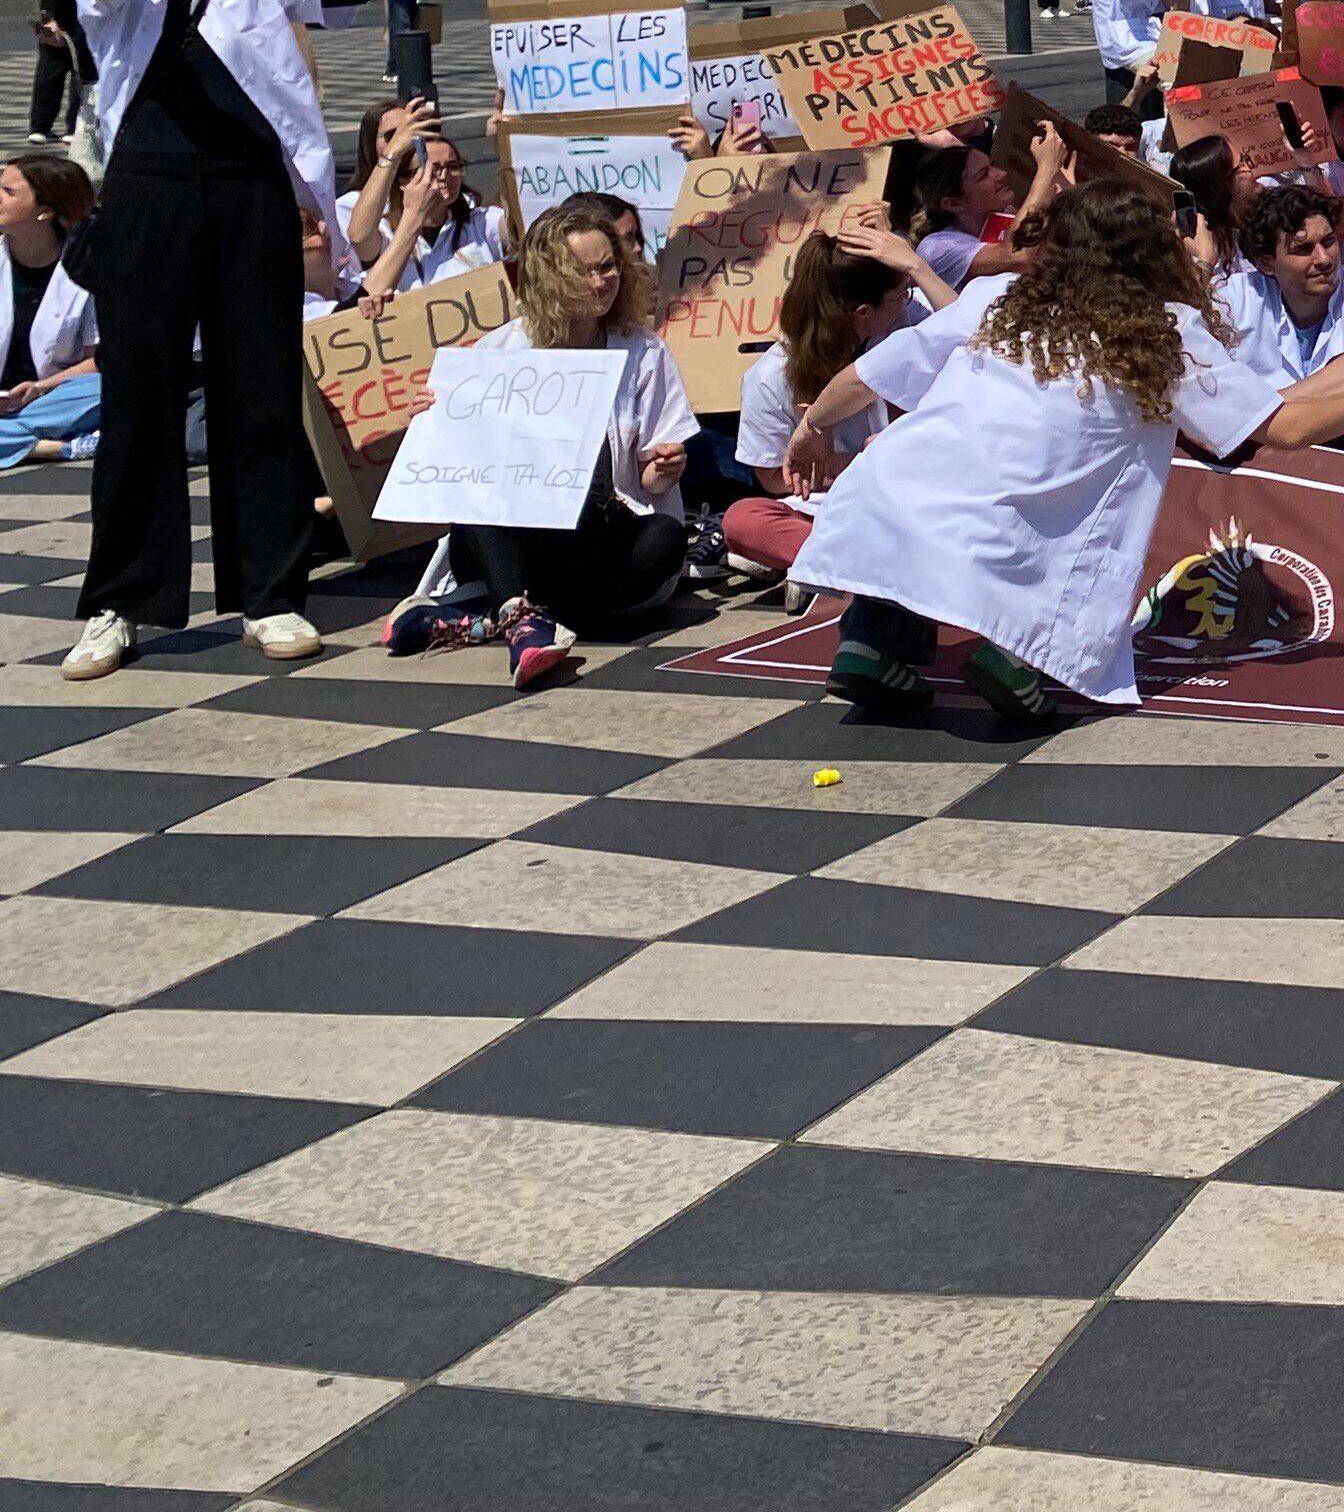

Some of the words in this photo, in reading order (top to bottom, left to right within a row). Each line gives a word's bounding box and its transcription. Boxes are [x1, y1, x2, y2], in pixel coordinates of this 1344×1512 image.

[616, 14, 667, 43] LES
[804, 53, 994, 122] PATIENTS
[519, 155, 662, 198] ABANDON
[693, 166, 763, 199] ON
[784, 161, 861, 196] NE
[679, 256, 754, 288] PAS
[425, 279, 512, 350] DU
[445, 366, 608, 421] GAROT
[398, 461, 496, 486] SOIGNE
[507, 463, 539, 487] TA
[542, 467, 588, 490] LOI
